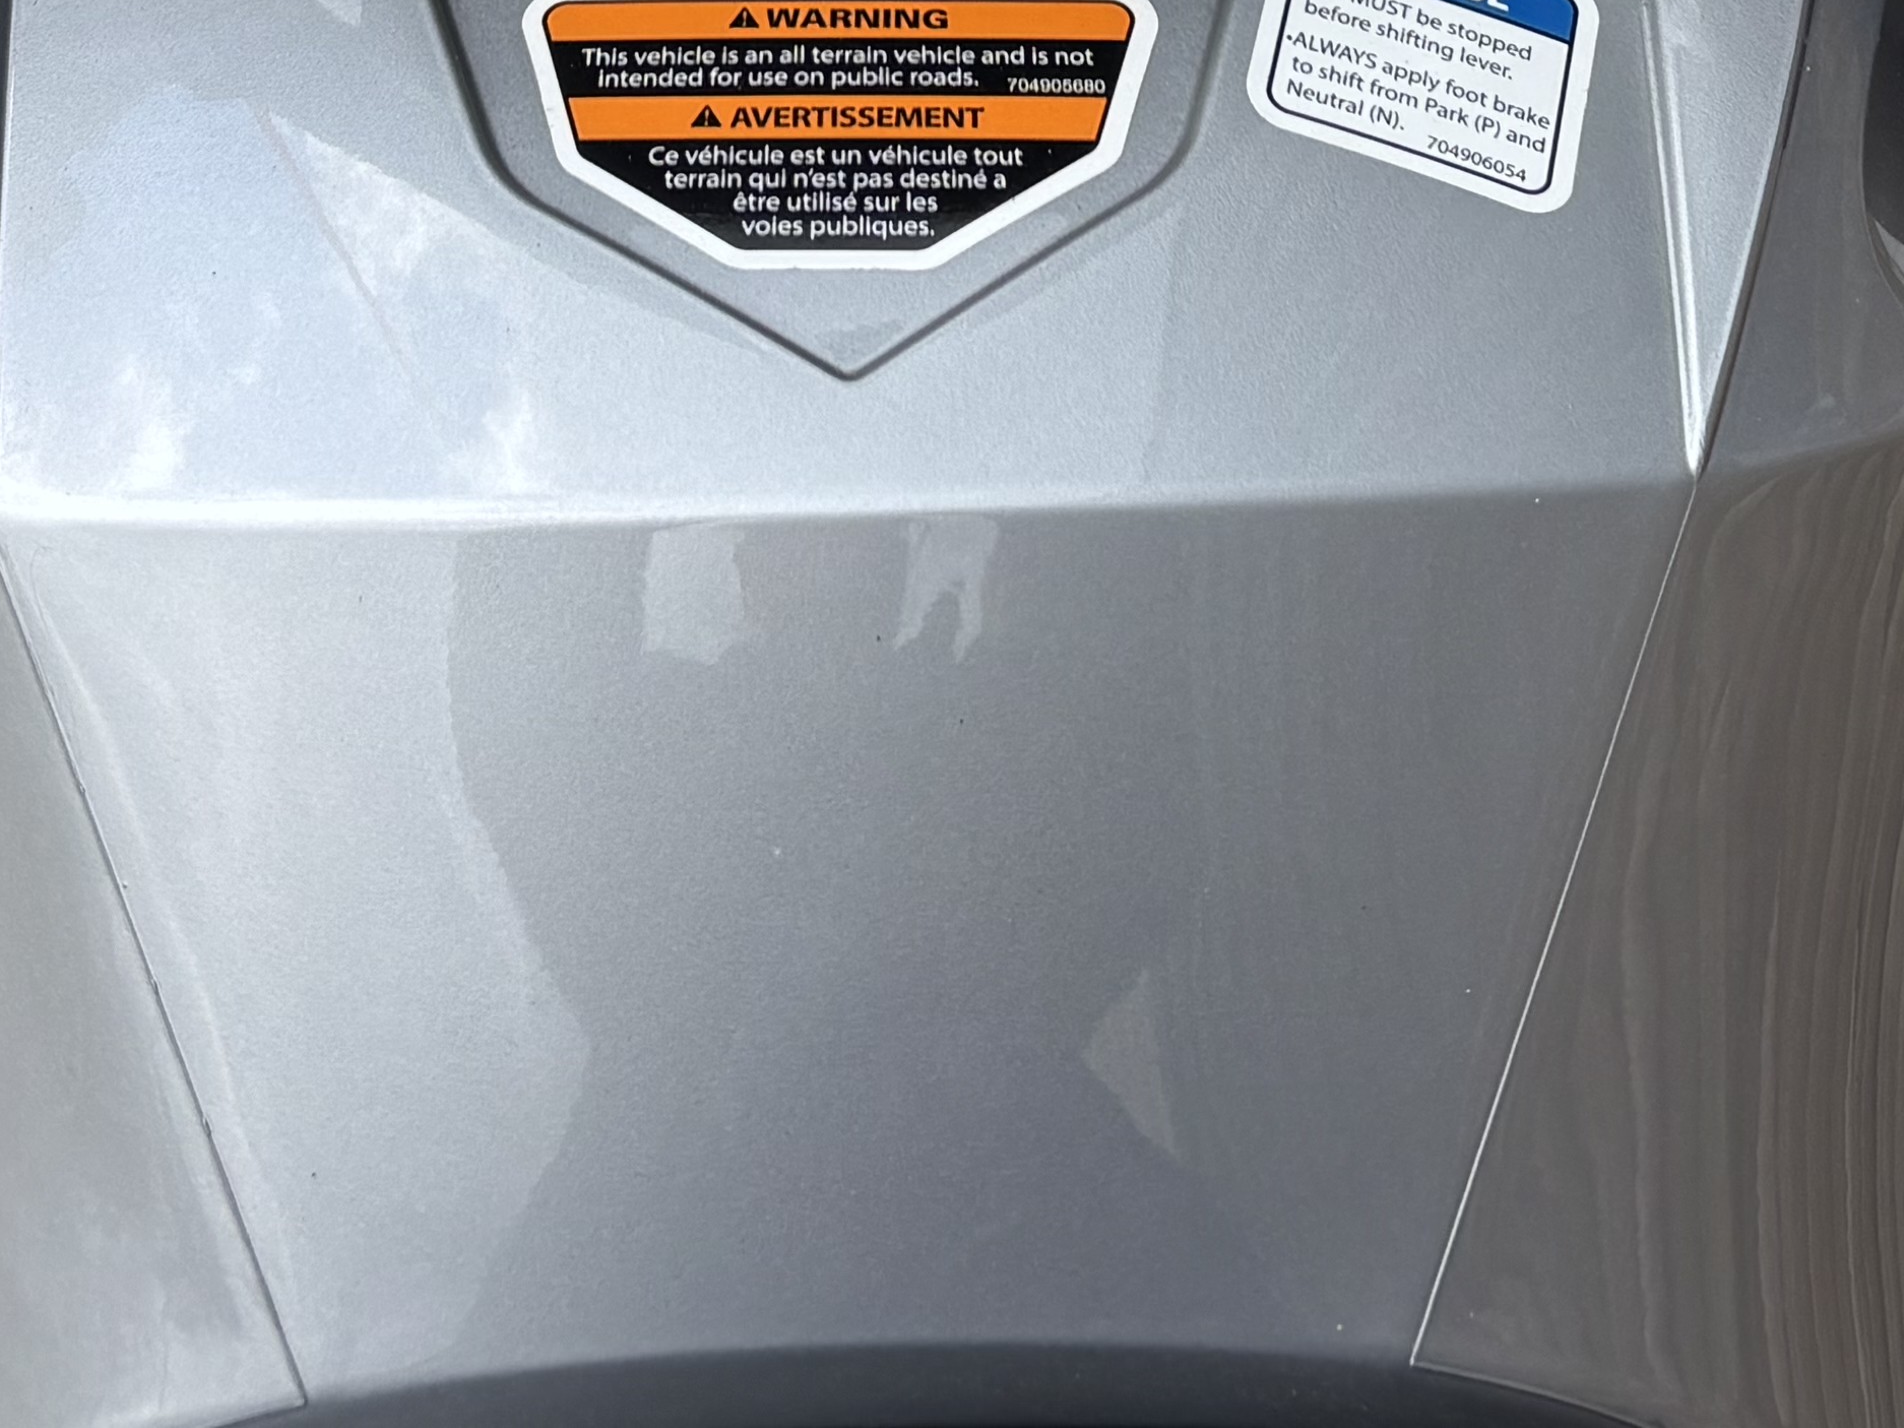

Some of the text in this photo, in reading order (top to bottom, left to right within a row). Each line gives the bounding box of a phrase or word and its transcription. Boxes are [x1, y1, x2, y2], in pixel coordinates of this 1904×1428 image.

[766, 8, 948, 29] WARNING
[1416, 8, 1442, 30] be
[1447, 23, 1531, 61] stopped
[581, 44, 1093, 66] This vehicle is an all terrain vehicle and is not
[1375, 22, 1453, 61] shifting
[1459, 46, 1512, 79] lever.
[598, 66, 978, 89] intended for use on public roads.
[1292, 30, 1550, 129] ALWAYS apply foot brake
[1286, 78, 1404, 130] Neutral (N).
[1292, 56, 1545, 153] to shift from Park (P) and
[730, 106, 984, 128] AVERTISSEMENT
[648, 144, 1022, 165] Ce véhicule est un véhicule tout
[1427, 135, 1525, 182] 704906054
[664, 168, 741, 188] terrain
[748, 168, 786, 192] qui
[853, 172, 893, 192] pas
[899, 167, 987, 188] destiné
[733, 190, 937, 212] être utilisé sur les
[741, 214, 934, 240] voies publiques.
